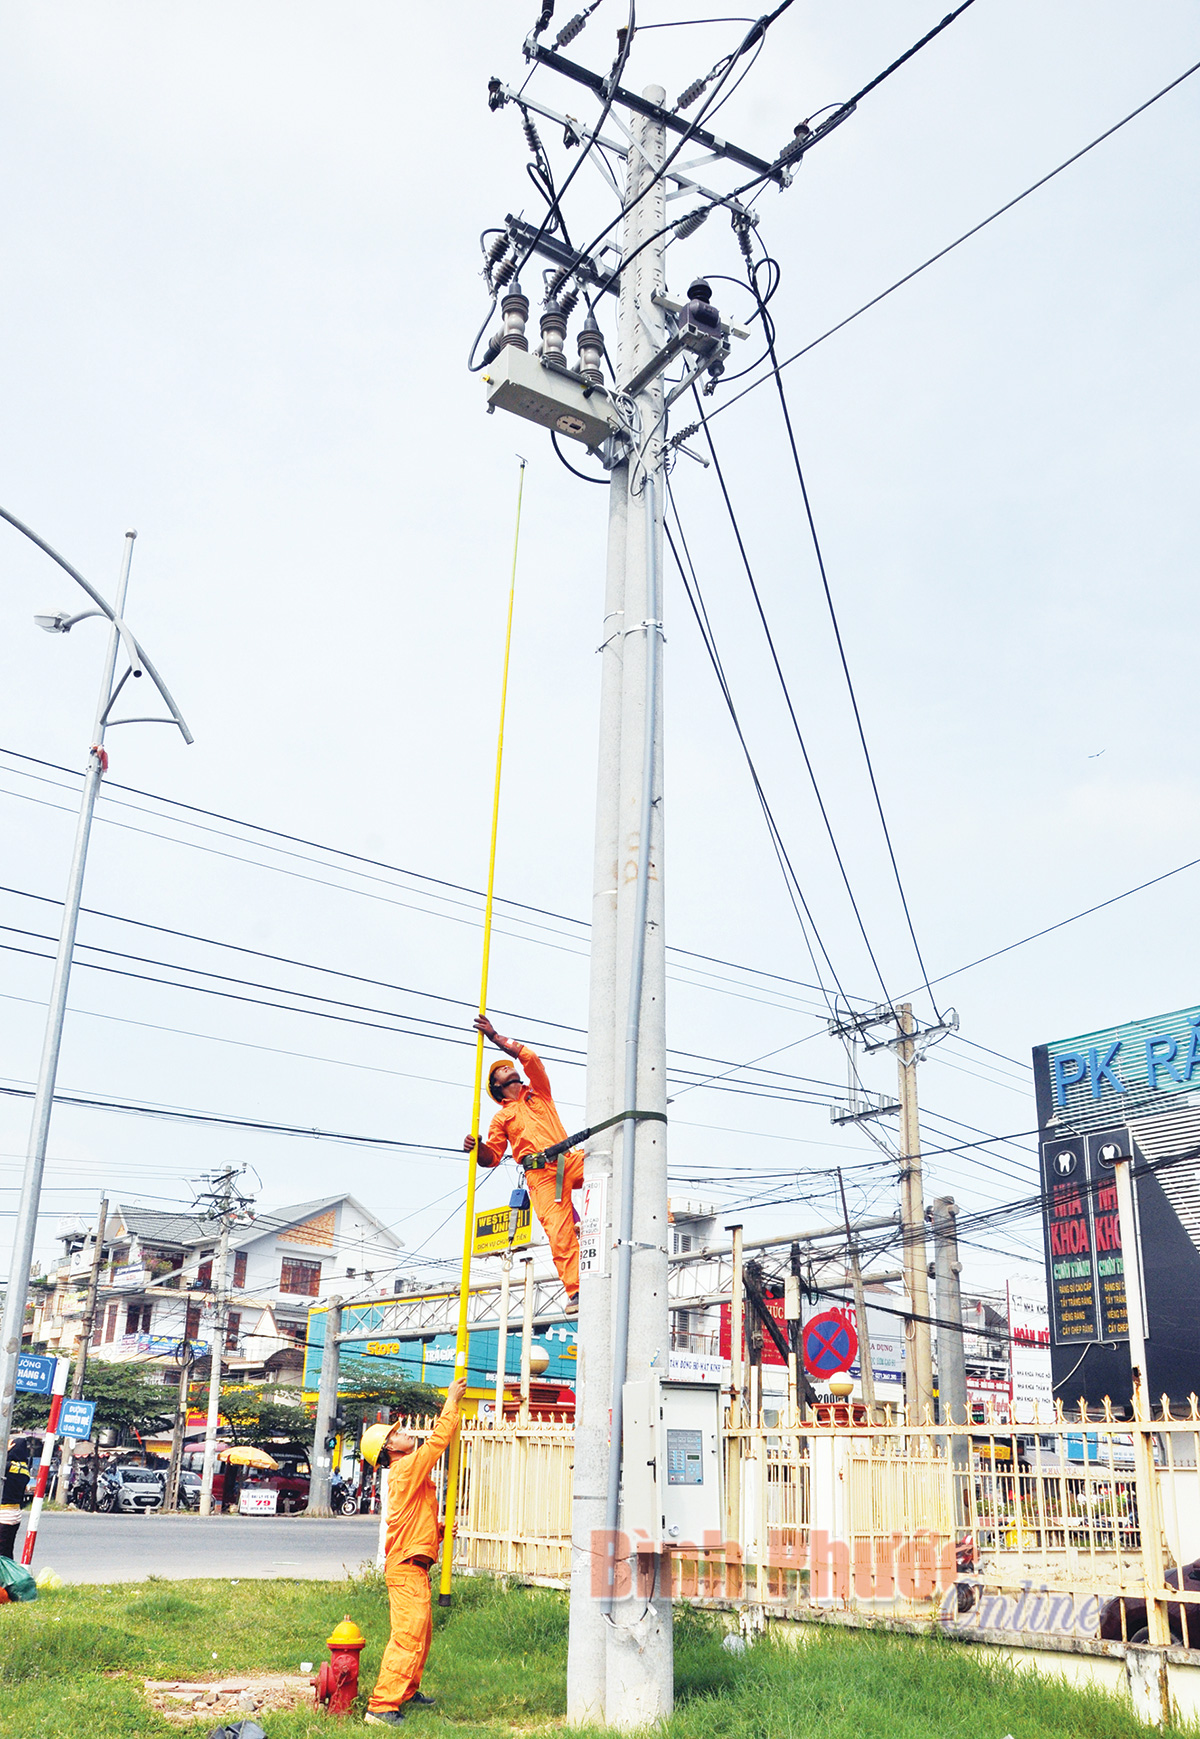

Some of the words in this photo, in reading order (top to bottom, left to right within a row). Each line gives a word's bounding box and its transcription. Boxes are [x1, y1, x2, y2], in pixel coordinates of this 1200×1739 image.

[1054, 1042, 1127, 1106] PK
[478, 1209, 521, 1228] WESTE
[1050, 1218, 1089, 1256] KHOA
[366, 1341, 400, 1356] Store
[40, 1372, 46, 1381] 4
